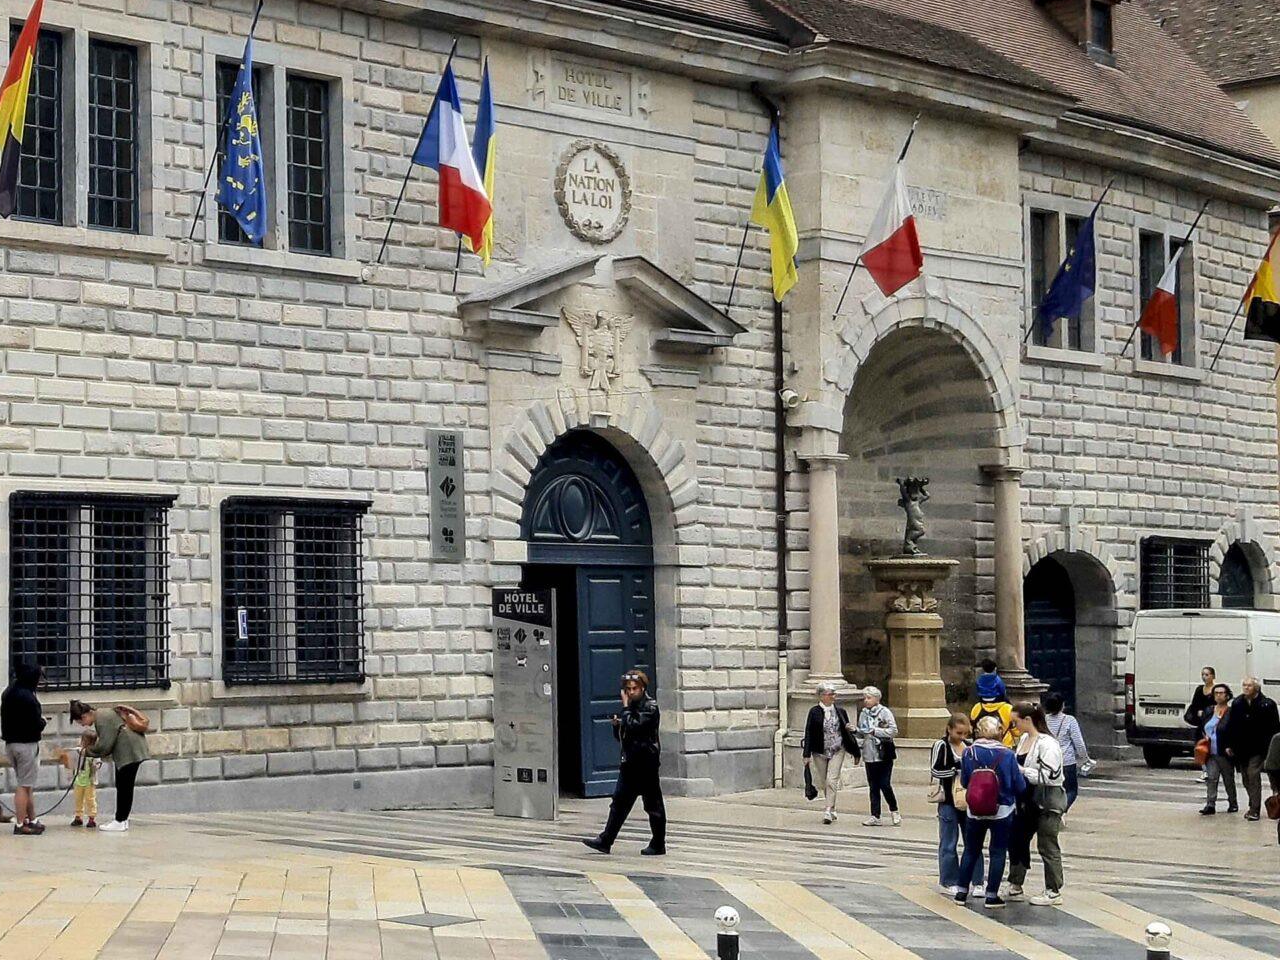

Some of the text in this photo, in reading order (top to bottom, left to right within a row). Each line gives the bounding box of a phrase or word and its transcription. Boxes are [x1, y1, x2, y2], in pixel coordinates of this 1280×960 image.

[558, 85, 622, 111] DE VILLE
[584, 158, 600, 174] LA
[568, 173, 615, 192] NATION
[572, 190, 612, 209] LA LOI
[504, 590, 539, 603] HÔTEL
[498, 603, 545, 614] DE VILLE
